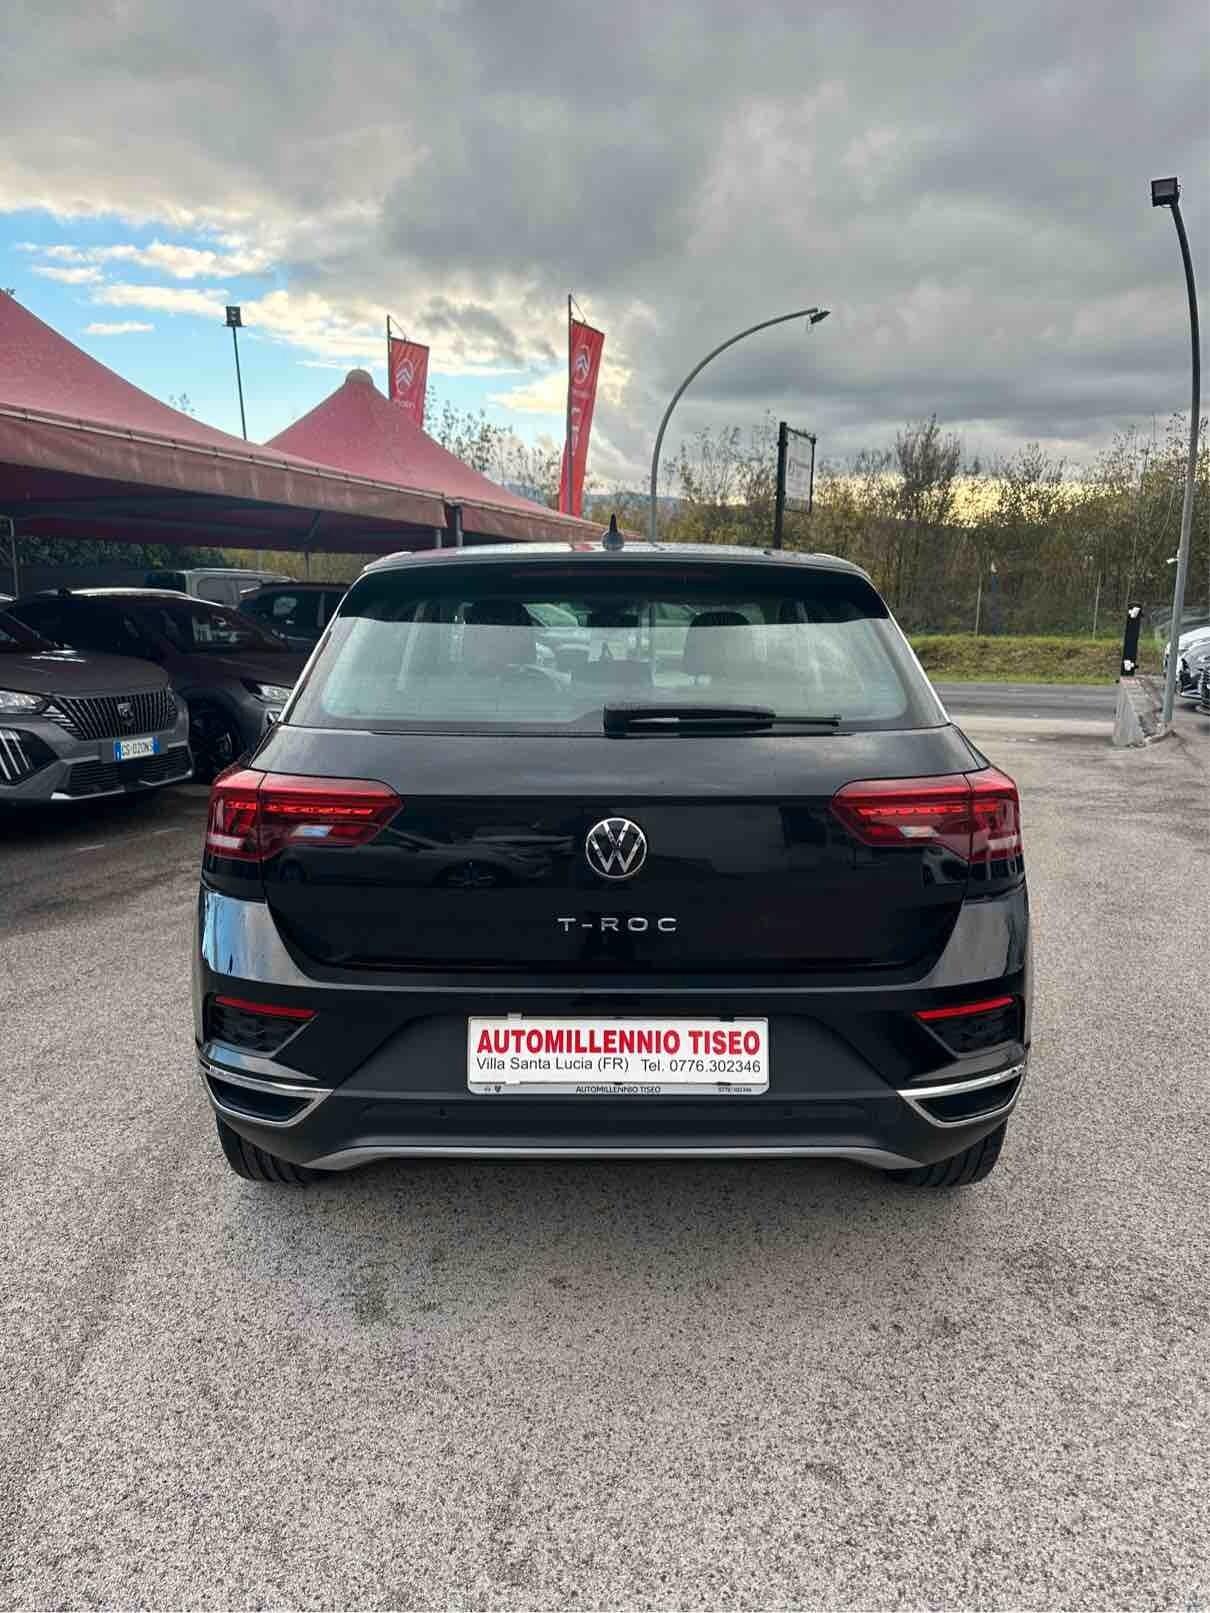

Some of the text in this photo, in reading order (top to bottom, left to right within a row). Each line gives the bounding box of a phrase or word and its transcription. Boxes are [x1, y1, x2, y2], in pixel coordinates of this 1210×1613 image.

[557, 917, 677, 932] T-ROC
[476, 1029, 761, 1055] AUTOMILLENNIO TISEO
[476, 1056, 761, 1073] Villa Santa Lucia (FR) Tel. 0776.302346
